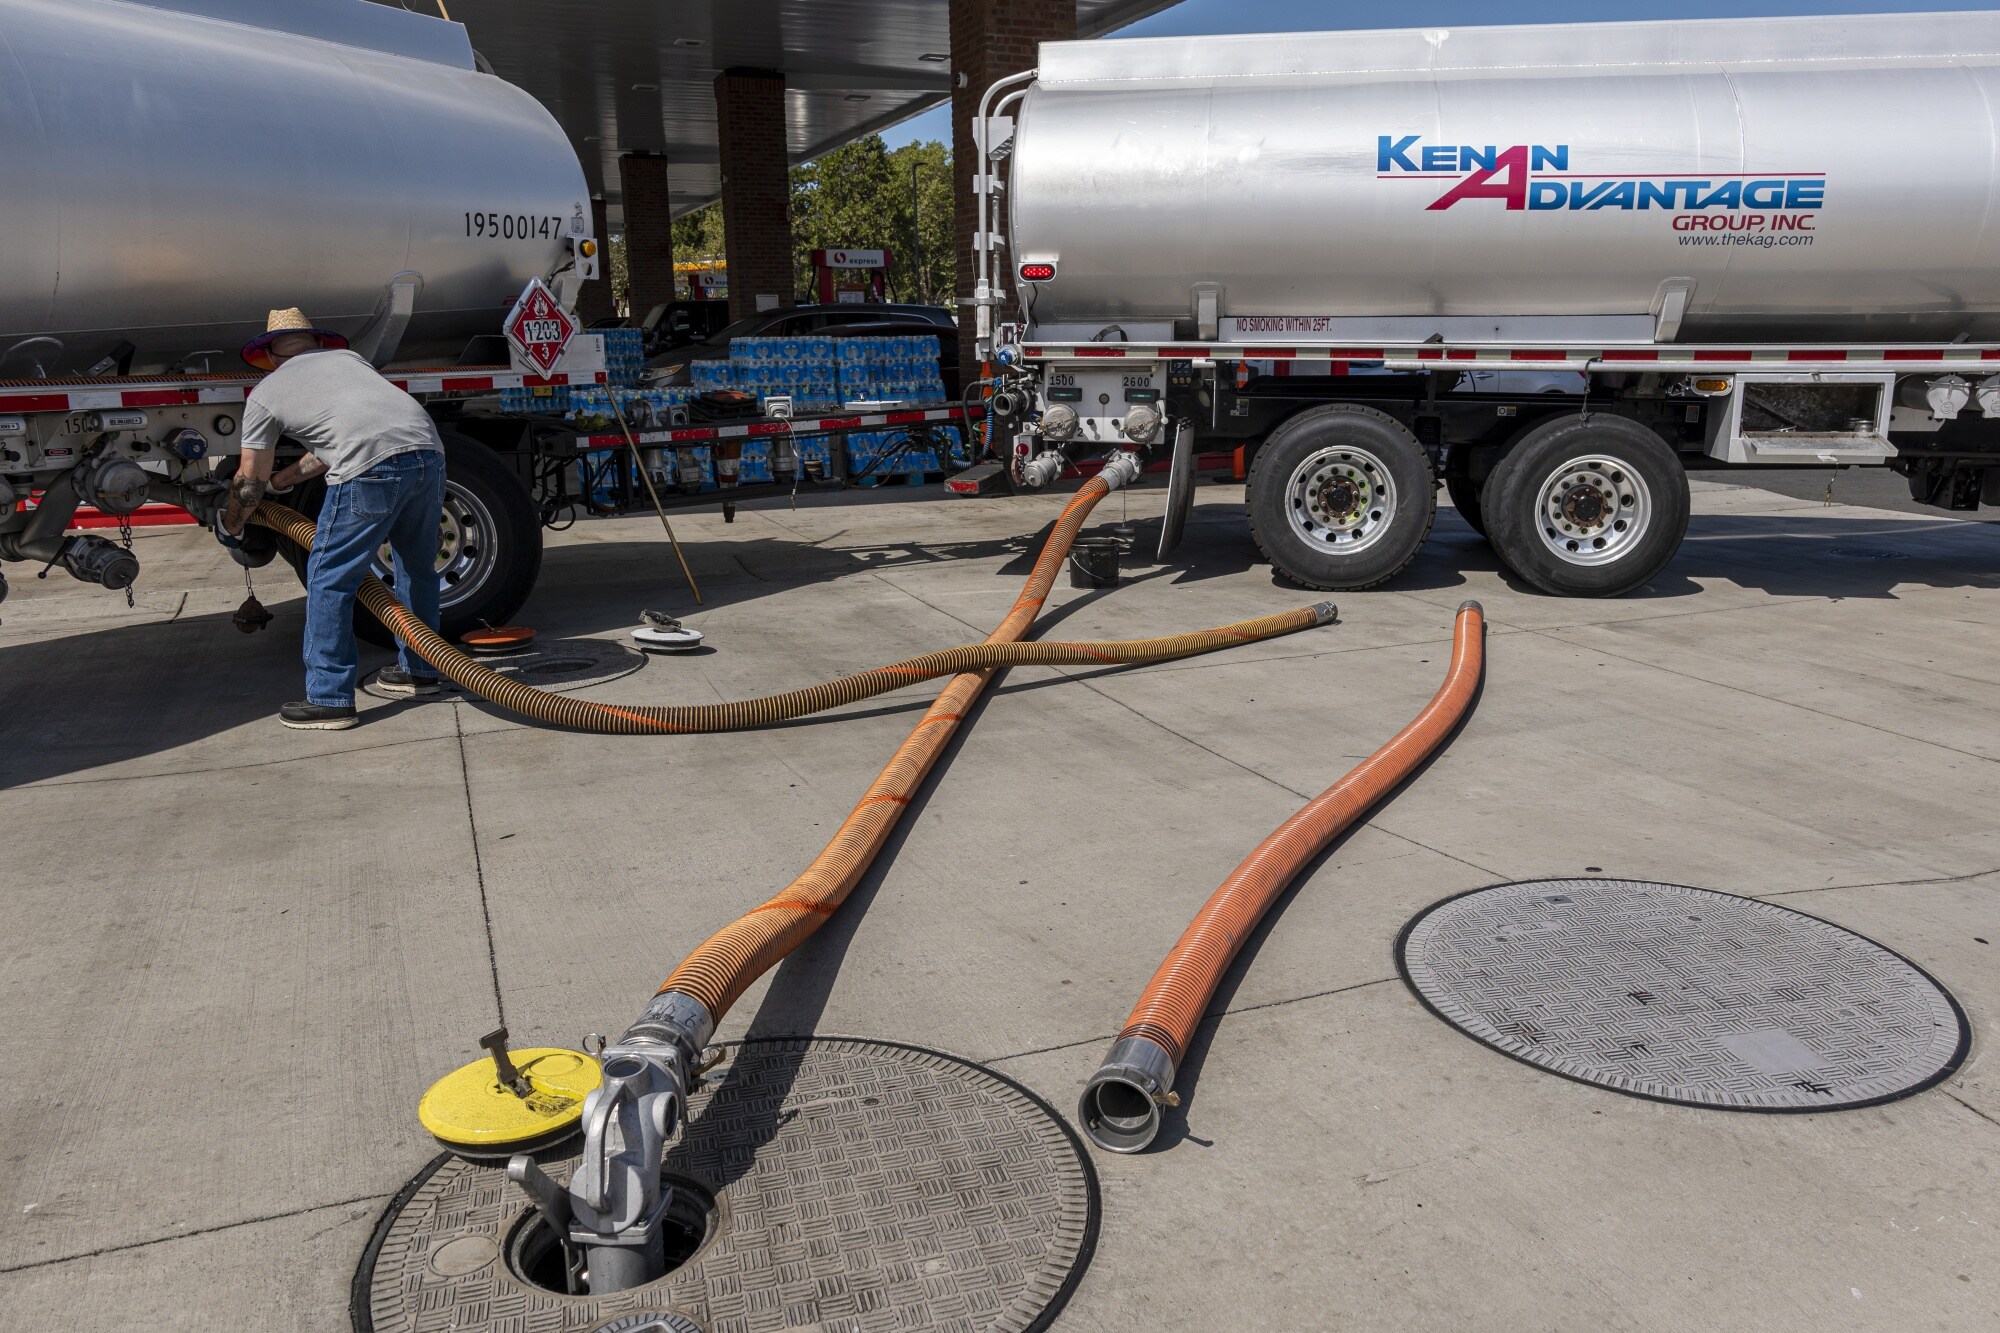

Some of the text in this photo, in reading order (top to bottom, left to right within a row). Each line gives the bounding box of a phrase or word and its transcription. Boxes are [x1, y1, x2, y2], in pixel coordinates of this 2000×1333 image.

[1377, 135, 1569, 178] KENAN
[1425, 145, 1826, 210] ADVANTAGE
[464, 212, 562, 240] 19500147
[1672, 214, 1816, 233] GROUP, INC.
[1678, 233, 1814, 248] www.thekag.com
[849, 257, 878, 265] express
[524, 320, 561, 341] 1203
[1236, 318, 1332, 332] NO SMOKING WITHIN 25FT.
[541, 346, 550, 360] 3
[1049, 376, 1074, 386] 1500
[1123, 376, 1149, 388] 2600
[1077, 428, 1084, 437] 2
[1, 441, 8, 450] 2
